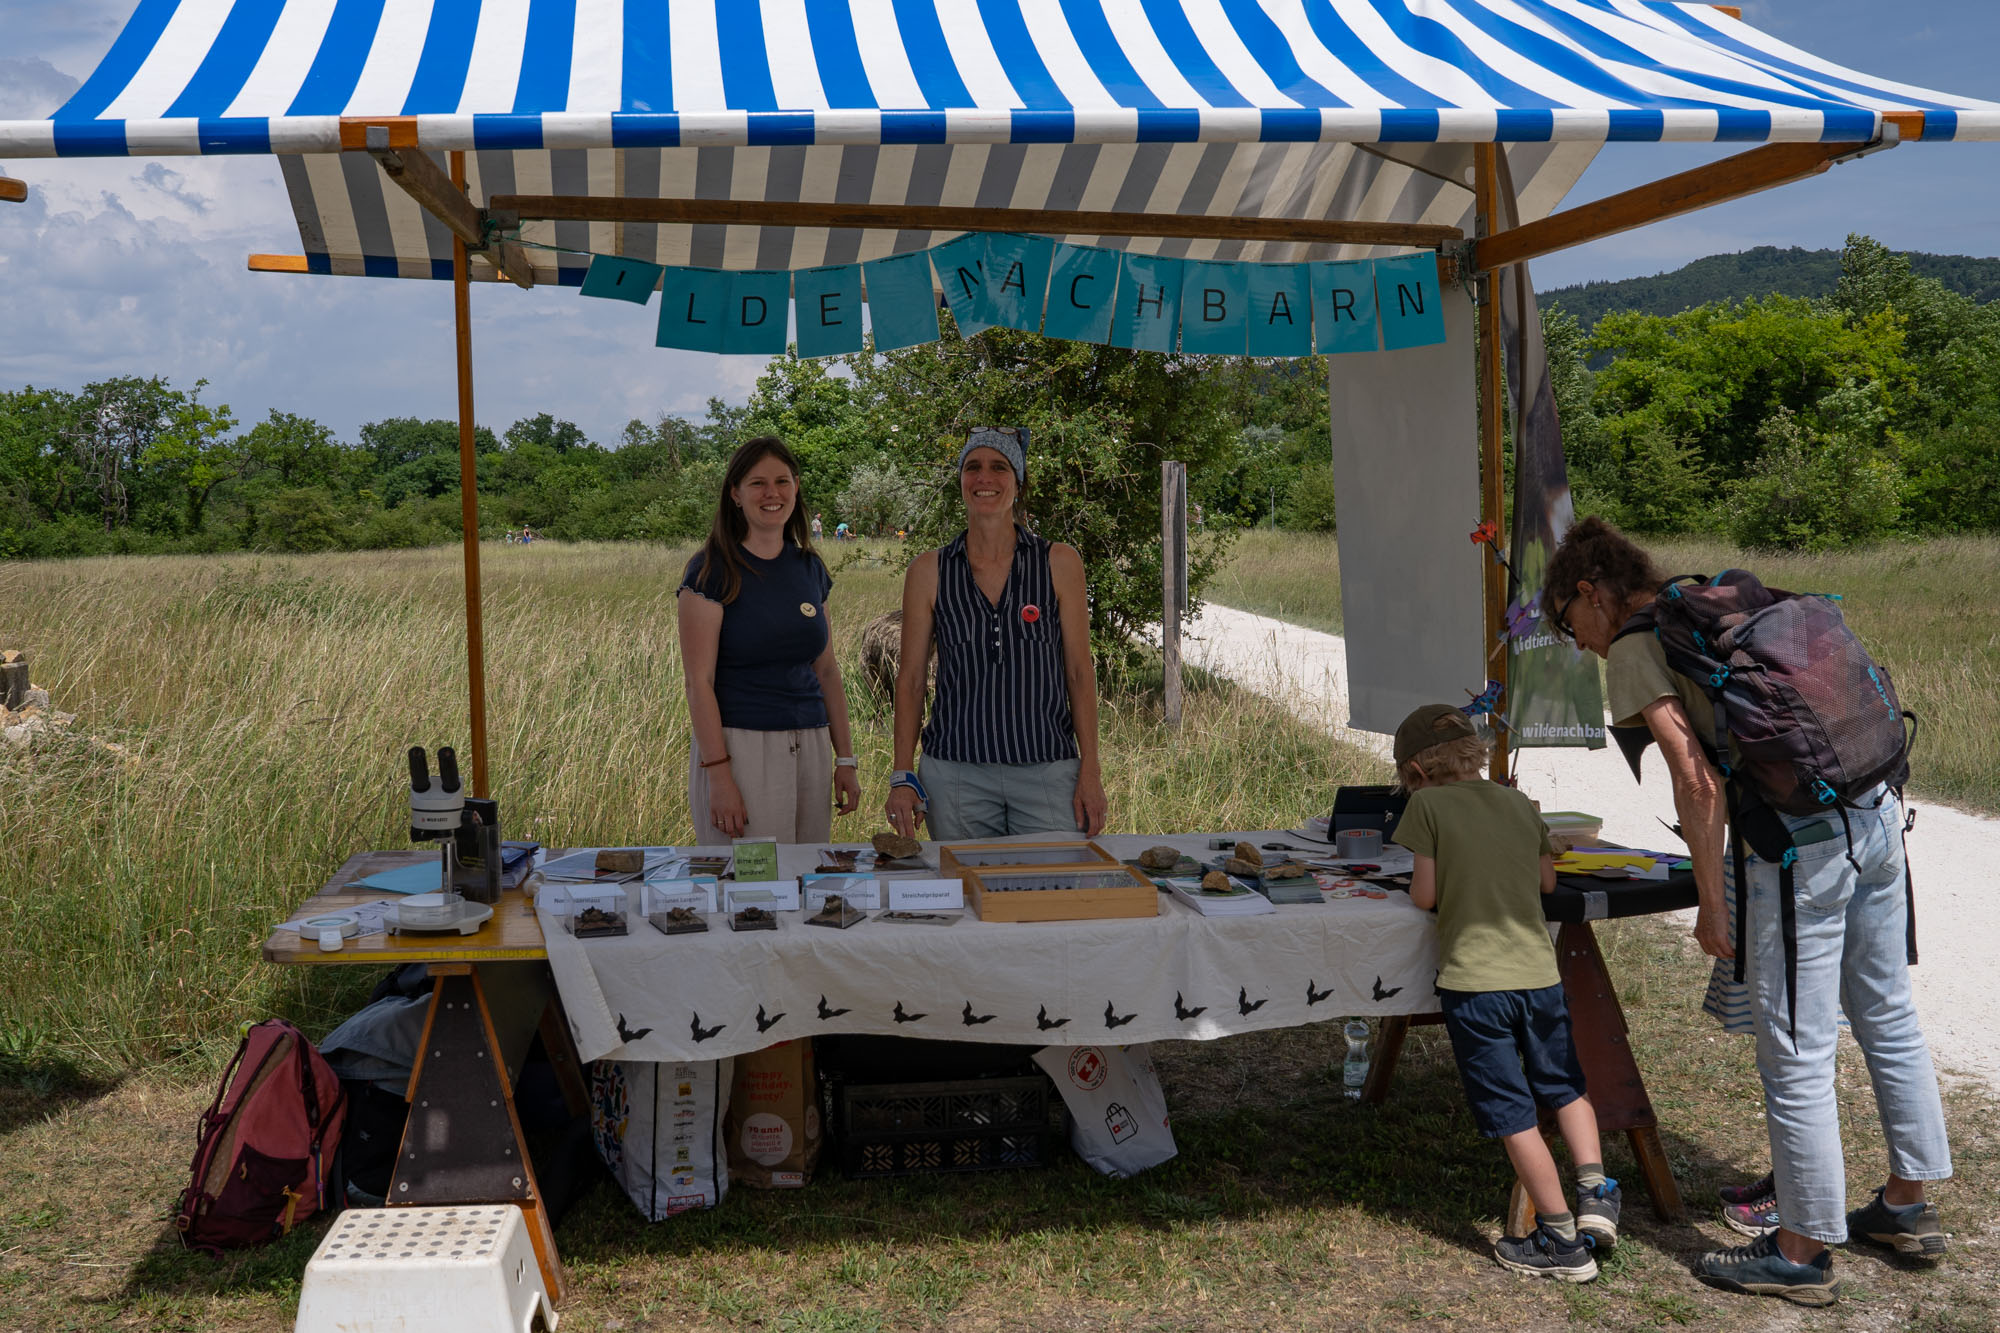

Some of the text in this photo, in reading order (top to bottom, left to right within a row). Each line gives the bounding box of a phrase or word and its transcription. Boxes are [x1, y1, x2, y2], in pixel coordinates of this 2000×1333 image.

[957, 259, 1426, 327] NACHBARN
[1867, 664, 1896, 721] DAKINE
[748, 1071, 783, 1081] Happy
[760, 1124, 783, 1134] anni
